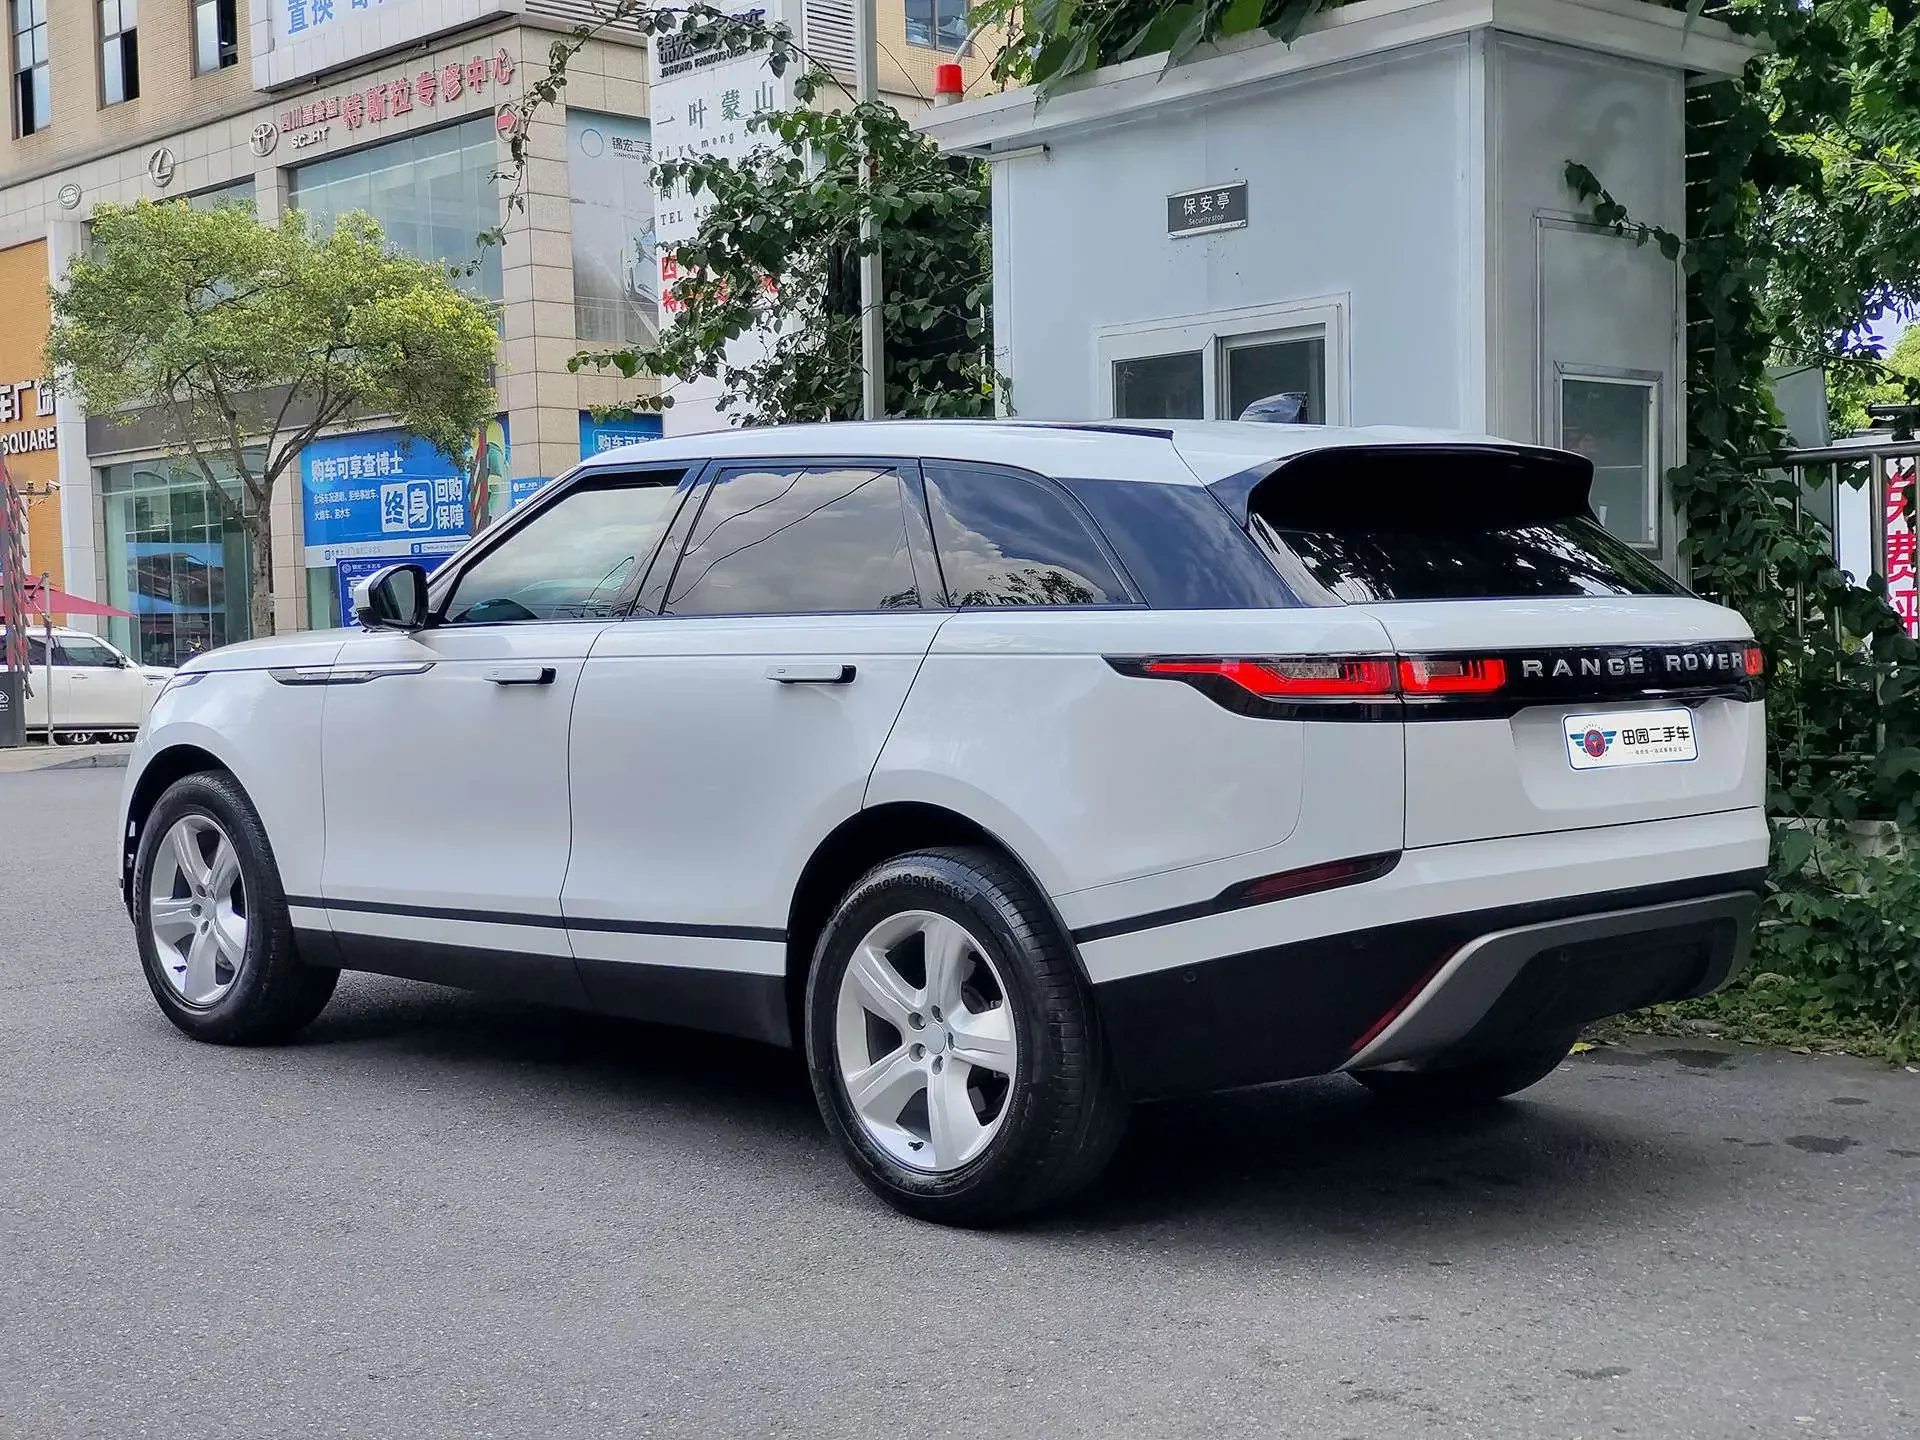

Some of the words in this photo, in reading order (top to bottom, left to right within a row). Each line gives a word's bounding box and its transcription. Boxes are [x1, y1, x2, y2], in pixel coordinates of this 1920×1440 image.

[1183, 191, 1231, 217] 保安亭
[660, 210, 684, 226] TEL
[311, 449, 404, 483] 购车可享查博士
[435, 477, 463, 503] 回购
[385, 487, 431, 525] 终身
[436, 503, 465, 530] 保障
[1522, 657, 1646, 679] RANGE
[1666, 651, 1743, 673] ROVER
[1621, 726, 1691, 746] 田园二手车
